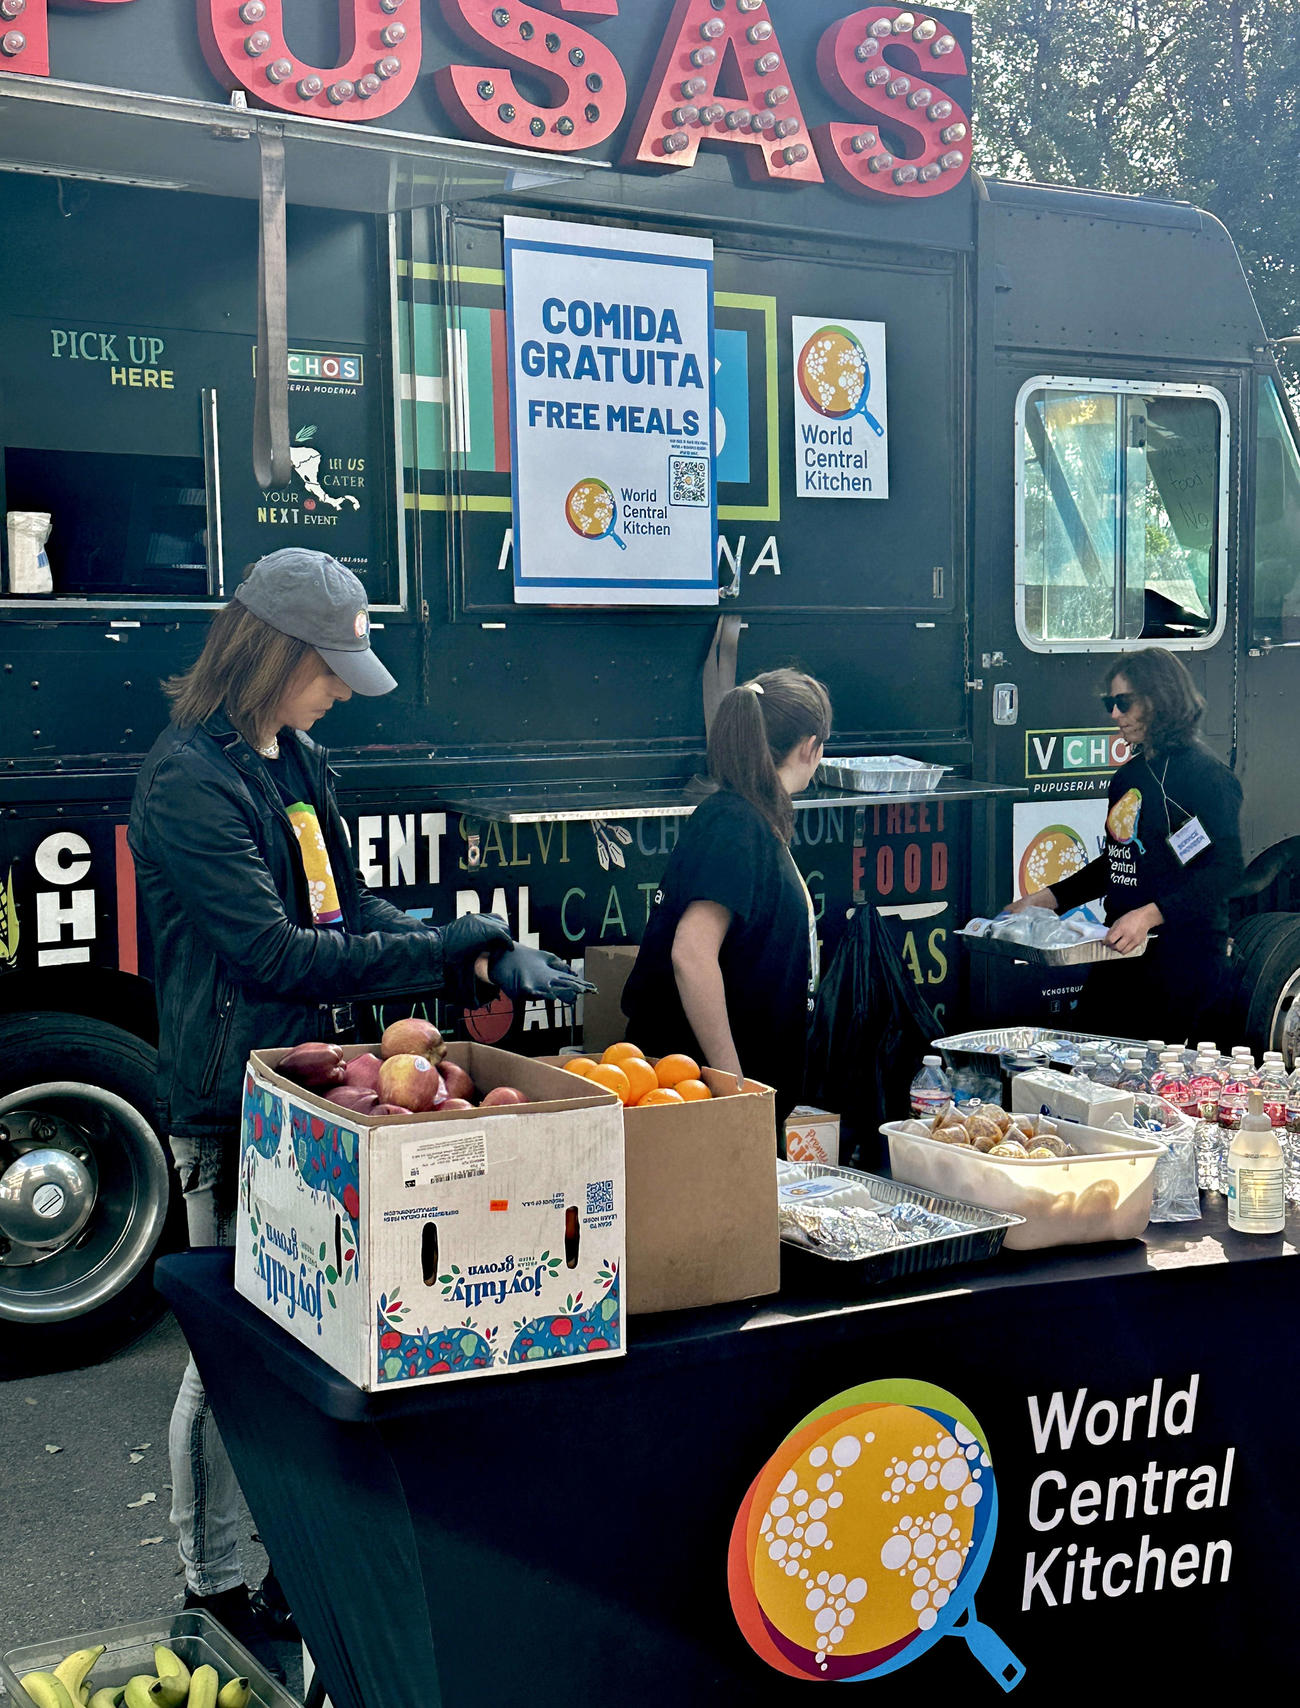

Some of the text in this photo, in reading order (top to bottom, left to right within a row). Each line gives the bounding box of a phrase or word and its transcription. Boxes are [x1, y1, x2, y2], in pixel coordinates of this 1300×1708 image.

[541, 297, 683, 345] COMIDA
[50, 329, 164, 365] PICK UP
[288, 357, 356, 378] CHOS
[520, 340, 704, 389] GRATUITA
[111, 366, 175, 389] HERE
[287, 383, 357, 396] ERIA MODERNA
[528, 400, 700, 437] FREE MEALS
[801, 424, 853, 446] World
[347, 458, 365, 471] US
[804, 448, 868, 469] Central
[323, 475, 365, 488] CATER
[805, 470, 872, 492] Kitchen
[262, 491, 299, 503] YOUR
[620, 487, 657, 503] World
[257, 507, 338, 526] NEXT EVENT
[623, 505, 668, 520] Central
[623, 521, 671, 536] Kitchen
[1033, 781, 1095, 793] PUPUSERIA
[864, 800, 945, 836] TREET
[339, 812, 447, 888] ENT
[1108, 844, 1131, 860] World
[852, 842, 949, 896] FOOD
[266, 1222, 299, 1256] grown
[468, 1254, 514, 1277] grown
[256, 1234, 326, 1336] joyfully
[449, 1265, 544, 1308] joyfully
[1027, 1373, 1200, 1454] World
[1028, 1447, 1236, 1532] Central
[1021, 1534, 1233, 1612] Kitchen
